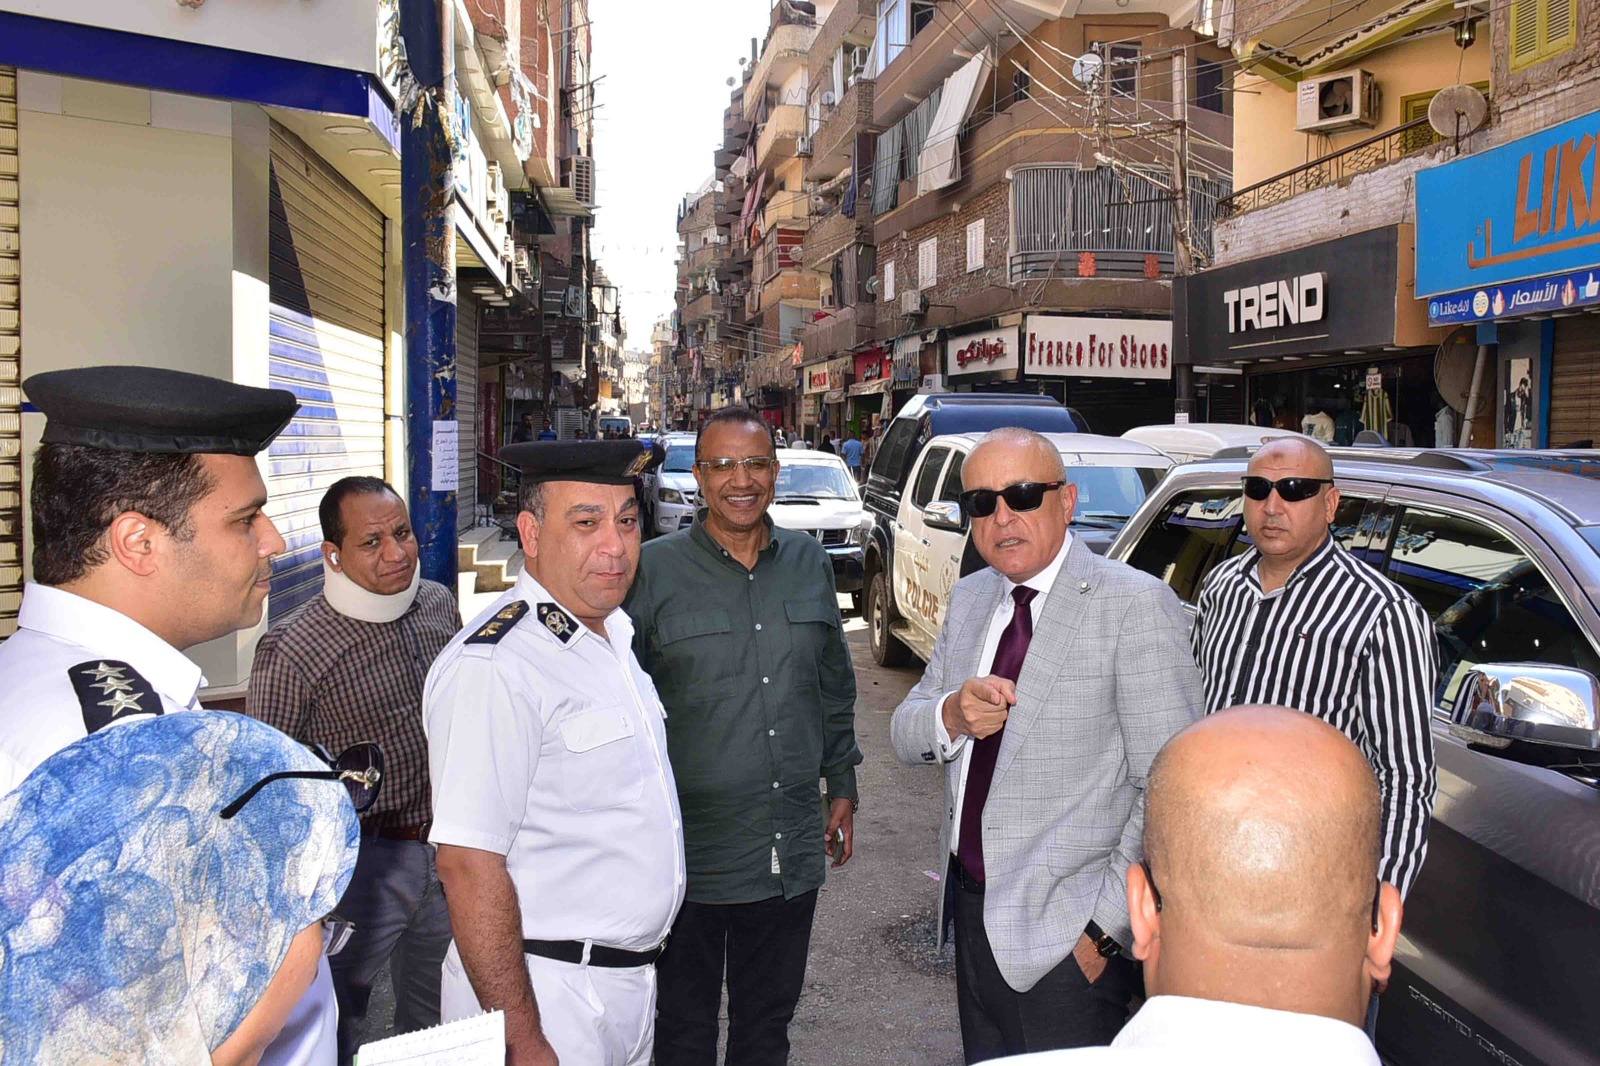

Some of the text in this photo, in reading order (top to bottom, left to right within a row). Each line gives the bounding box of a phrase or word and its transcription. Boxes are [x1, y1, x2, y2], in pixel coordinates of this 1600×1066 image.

[1513, 131, 1600, 245] LIK
[1224, 272, 1325, 333] TREND
[1440, 301, 1457, 316] Like
[1509, 282, 1558, 309] الأسعار
[1028, 333, 1168, 369] France For Shoes
